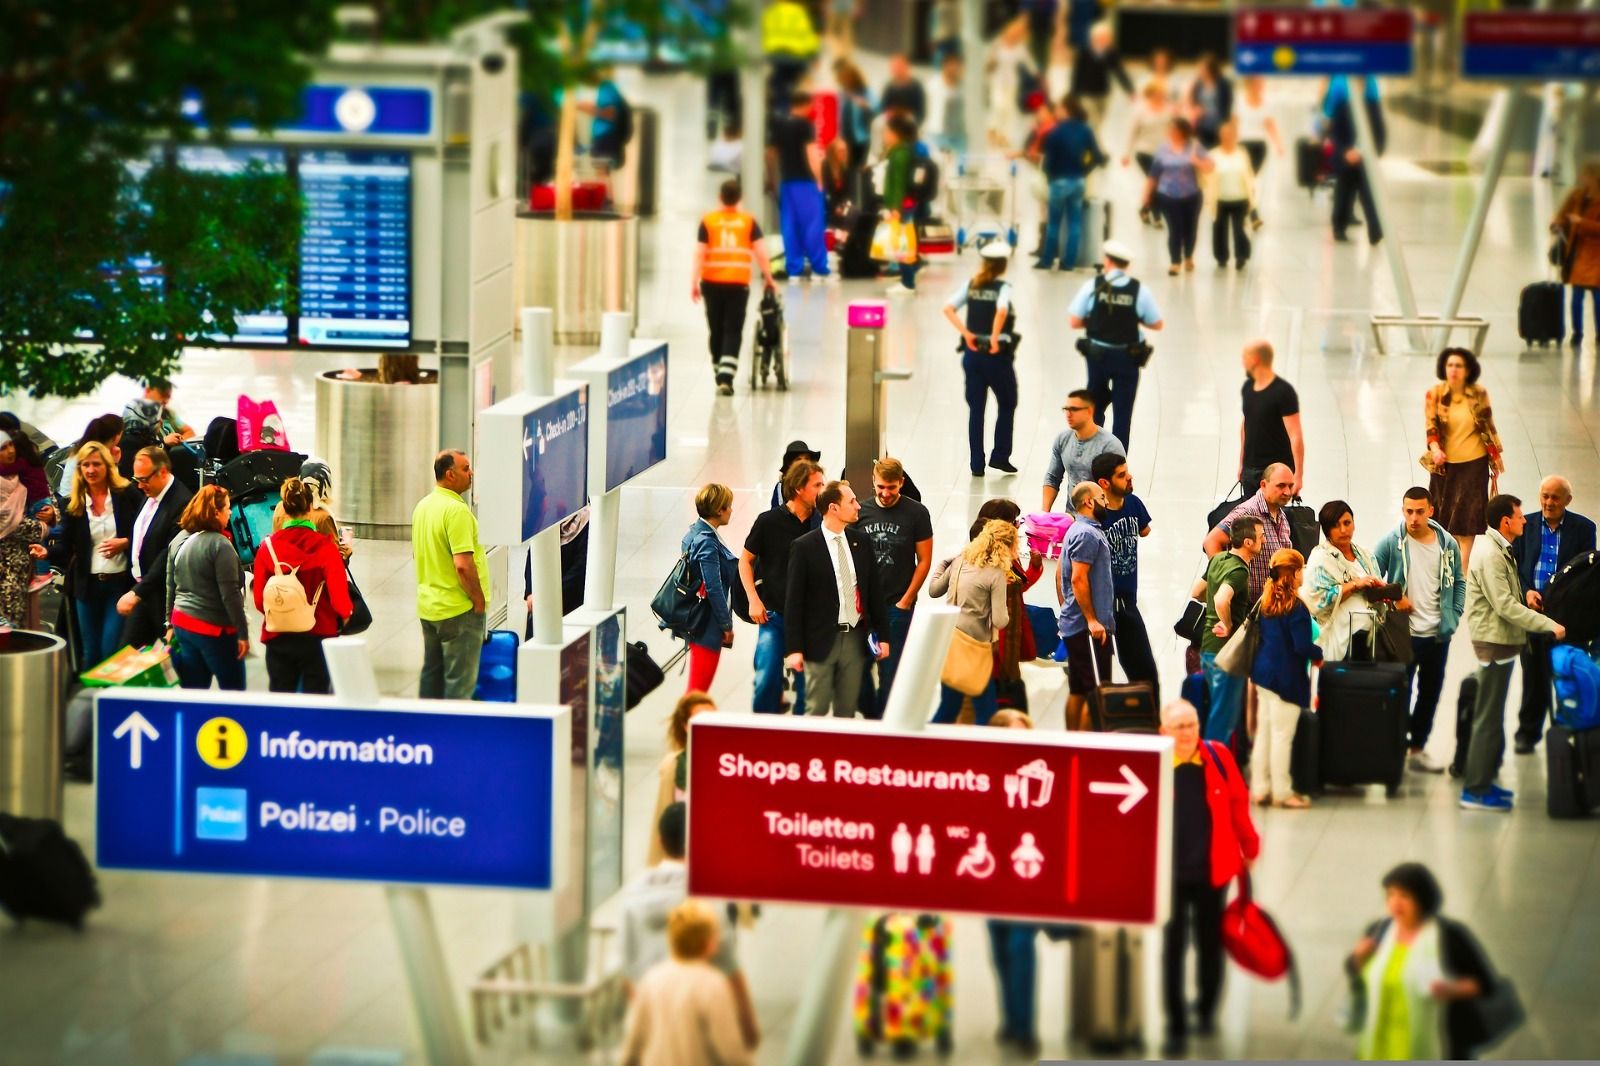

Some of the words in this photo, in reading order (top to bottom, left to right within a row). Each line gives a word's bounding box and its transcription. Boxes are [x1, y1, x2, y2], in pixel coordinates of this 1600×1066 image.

[1099, 292, 1134, 306] POLIZEI
[864, 522, 900, 535] KAUAI
[260, 730, 433, 765] Information
[719, 753, 800, 785] Shops
[807, 758, 827, 783] &
[834, 759, 991, 792] Restaurants
[260, 801, 356, 832] Polizei
[379, 806, 466, 837] Police
[763, 811, 875, 840] Toiletten
[796, 843, 875, 871] Toilets
